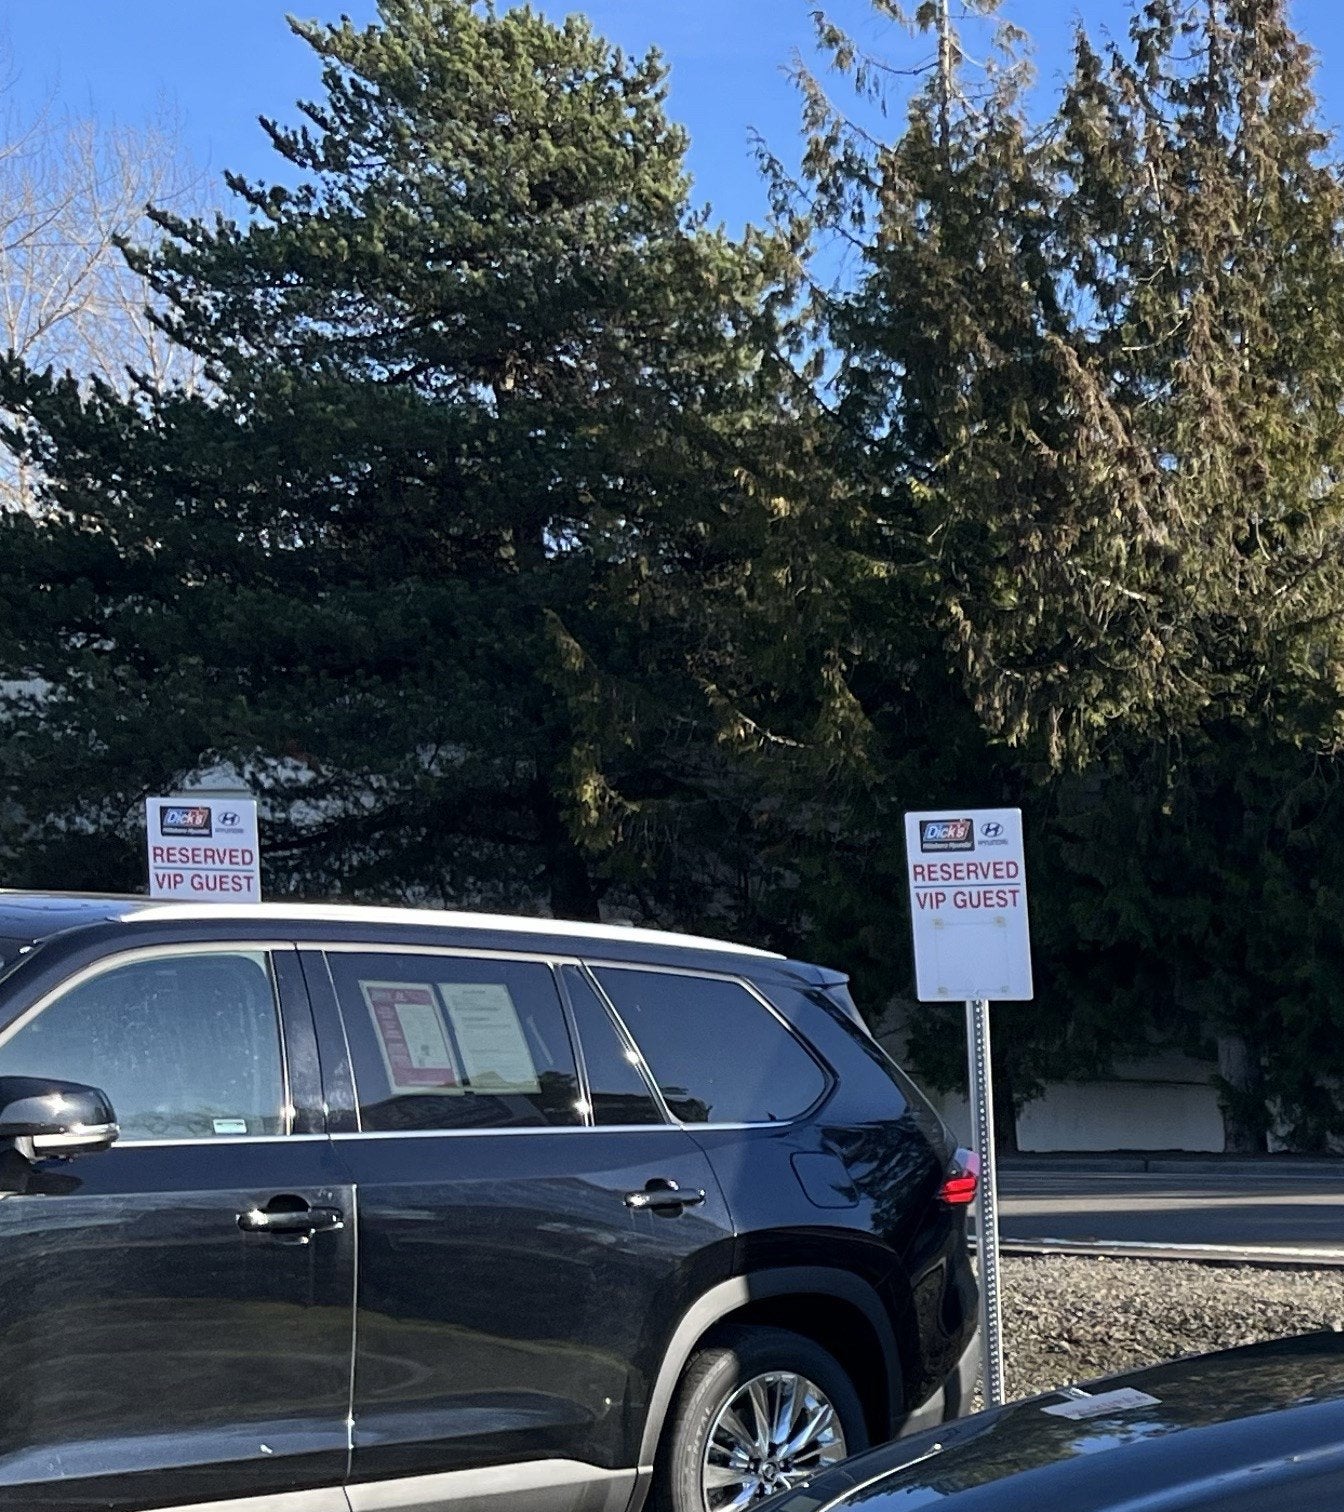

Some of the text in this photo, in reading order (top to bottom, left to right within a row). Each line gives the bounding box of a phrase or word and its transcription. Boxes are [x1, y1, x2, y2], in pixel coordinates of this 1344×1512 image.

[153, 846, 254, 866] RESERVED
[913, 861, 1019, 882] RESERVED
[155, 873, 255, 892] VIP GUEST
[915, 890, 1020, 910] VIP GUEST
